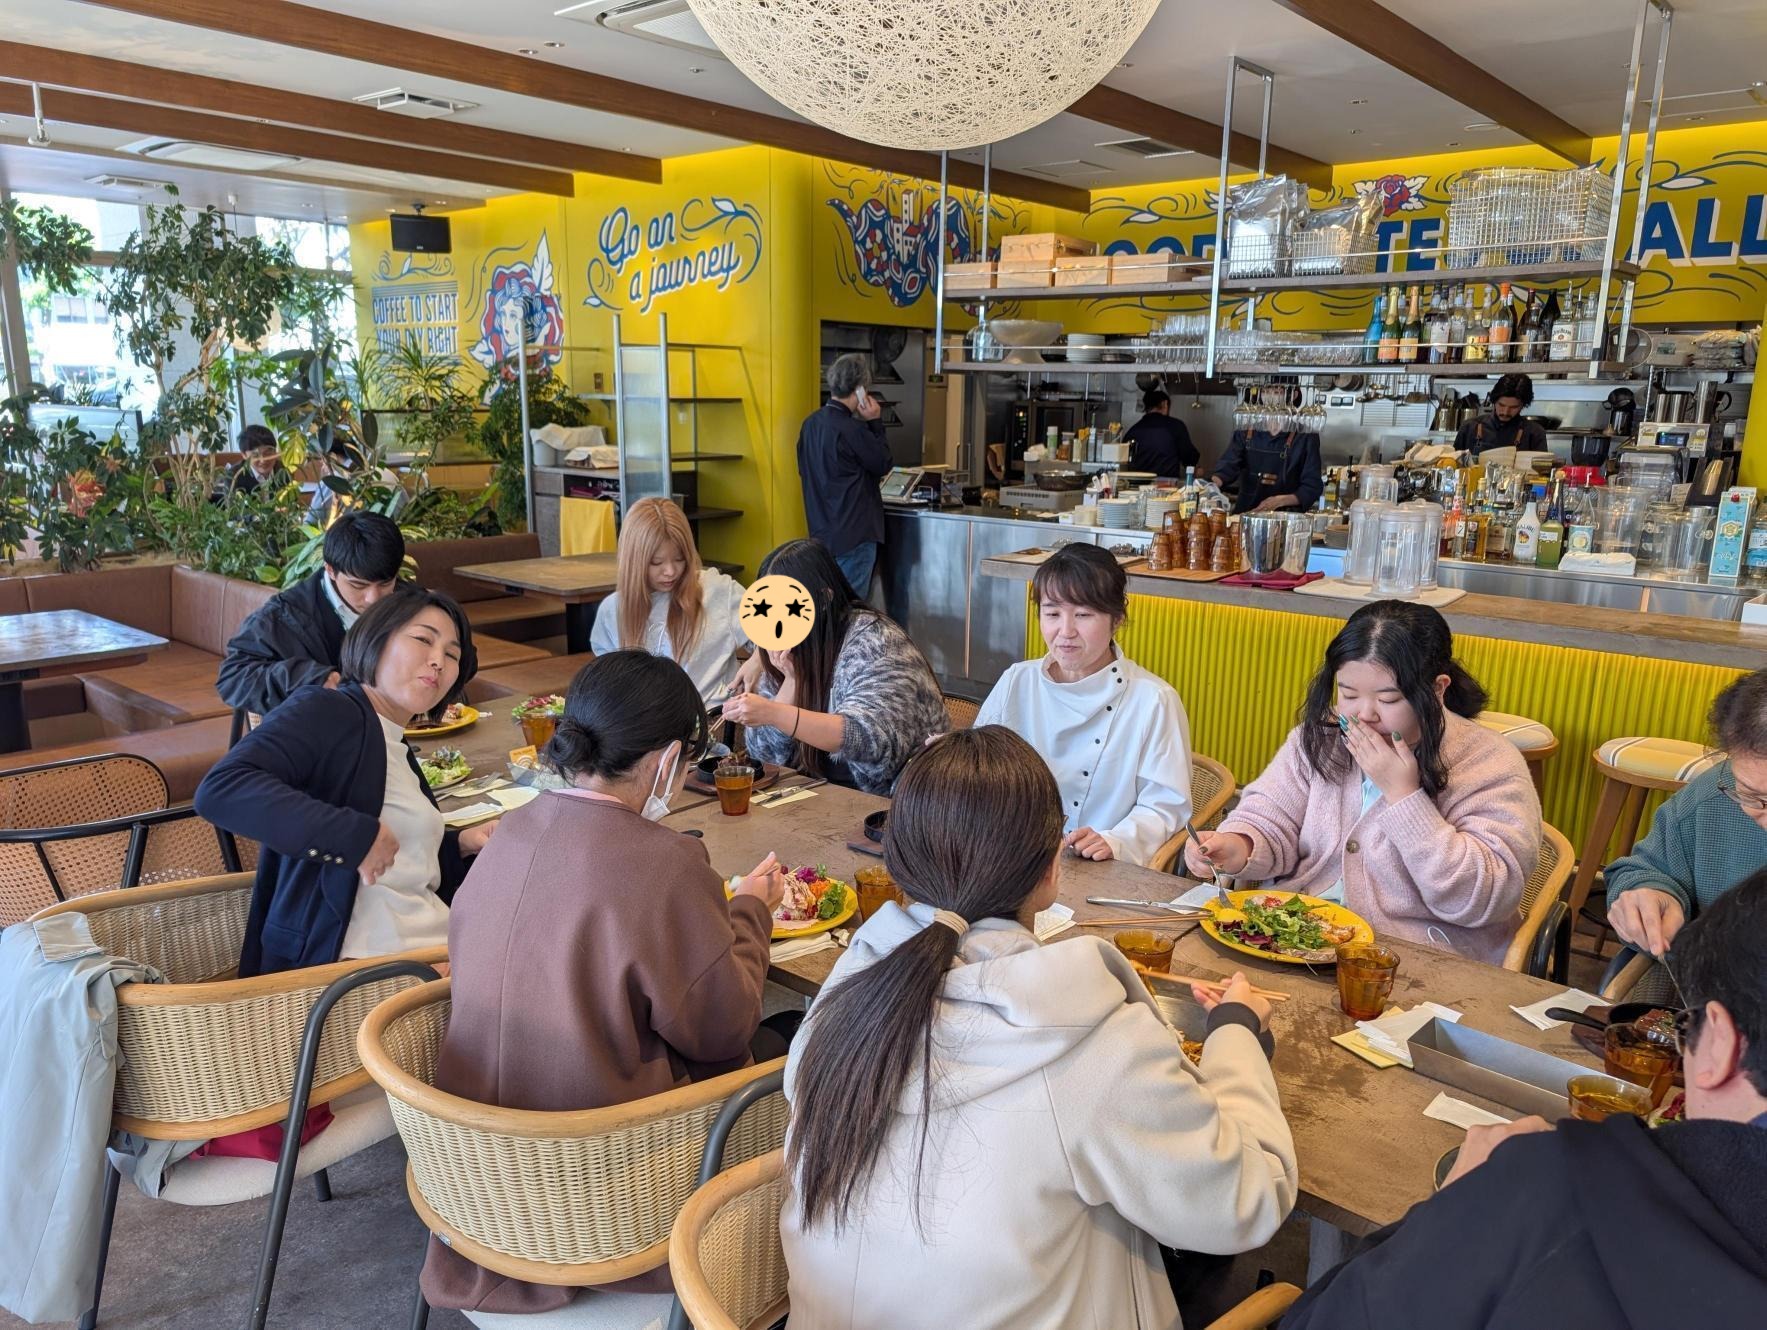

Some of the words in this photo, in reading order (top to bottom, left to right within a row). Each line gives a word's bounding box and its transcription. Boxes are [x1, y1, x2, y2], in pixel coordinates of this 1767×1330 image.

[599, 206, 640, 275] Go
[629, 270, 642, 303] a
[640, 241, 742, 315] journey
[372, 295, 407, 324] COFFEE
[409, 294, 423, 322] TO
[425, 292, 458, 322] START
[427, 325, 458, 353] RIGHT
